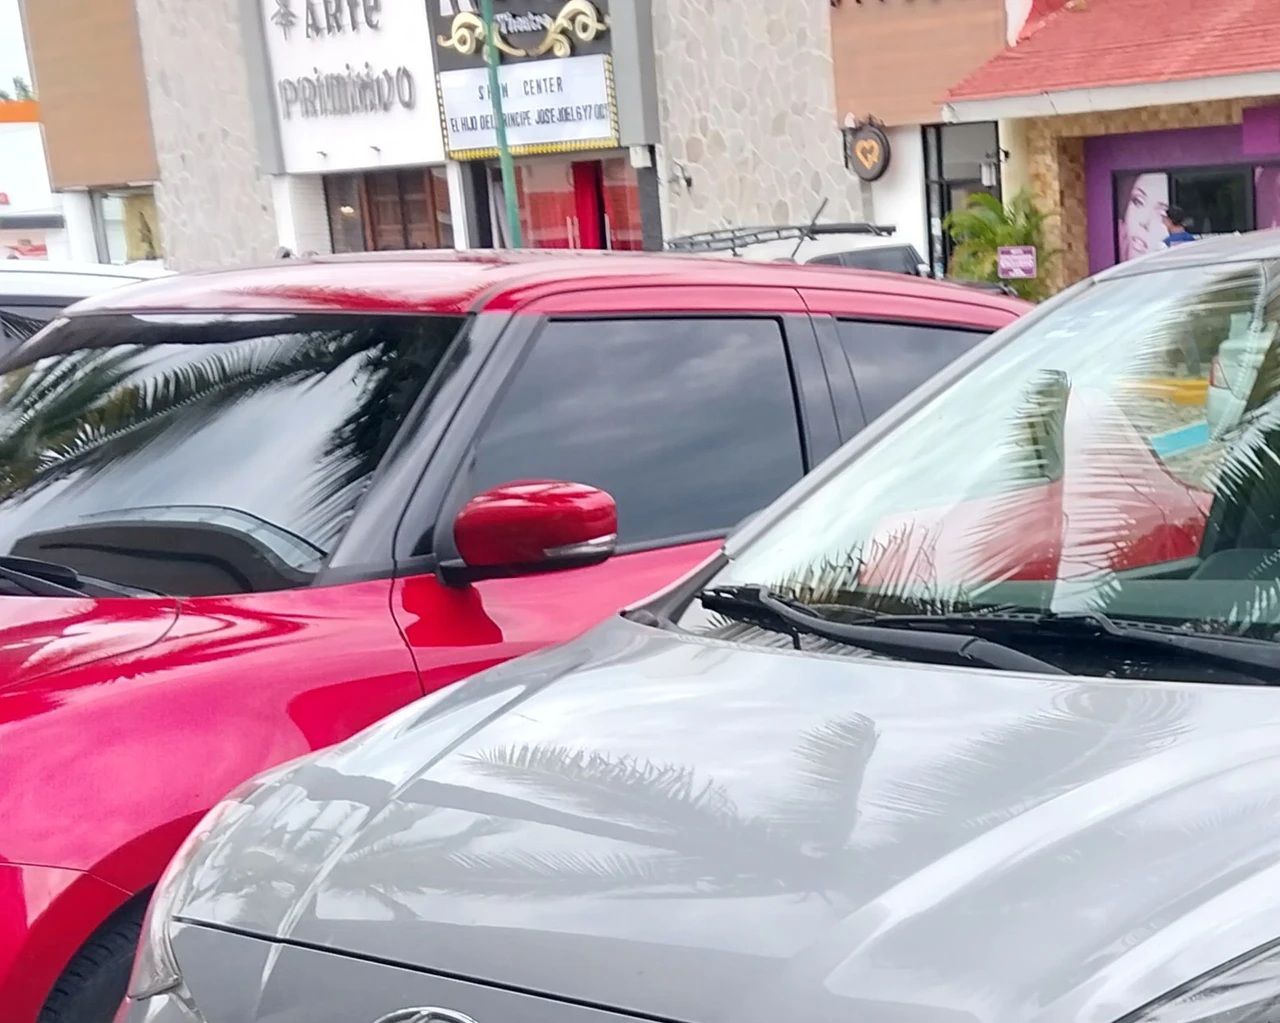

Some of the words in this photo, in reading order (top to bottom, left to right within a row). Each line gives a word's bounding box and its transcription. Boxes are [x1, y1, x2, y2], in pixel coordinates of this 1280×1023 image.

[523, 77, 563, 96] CENTER
[450, 117, 459, 132] EL
[460, 115, 477, 132] HIJO
[500, 109, 531, 128] RINCIPE
[535, 107, 555, 124] JOSE
